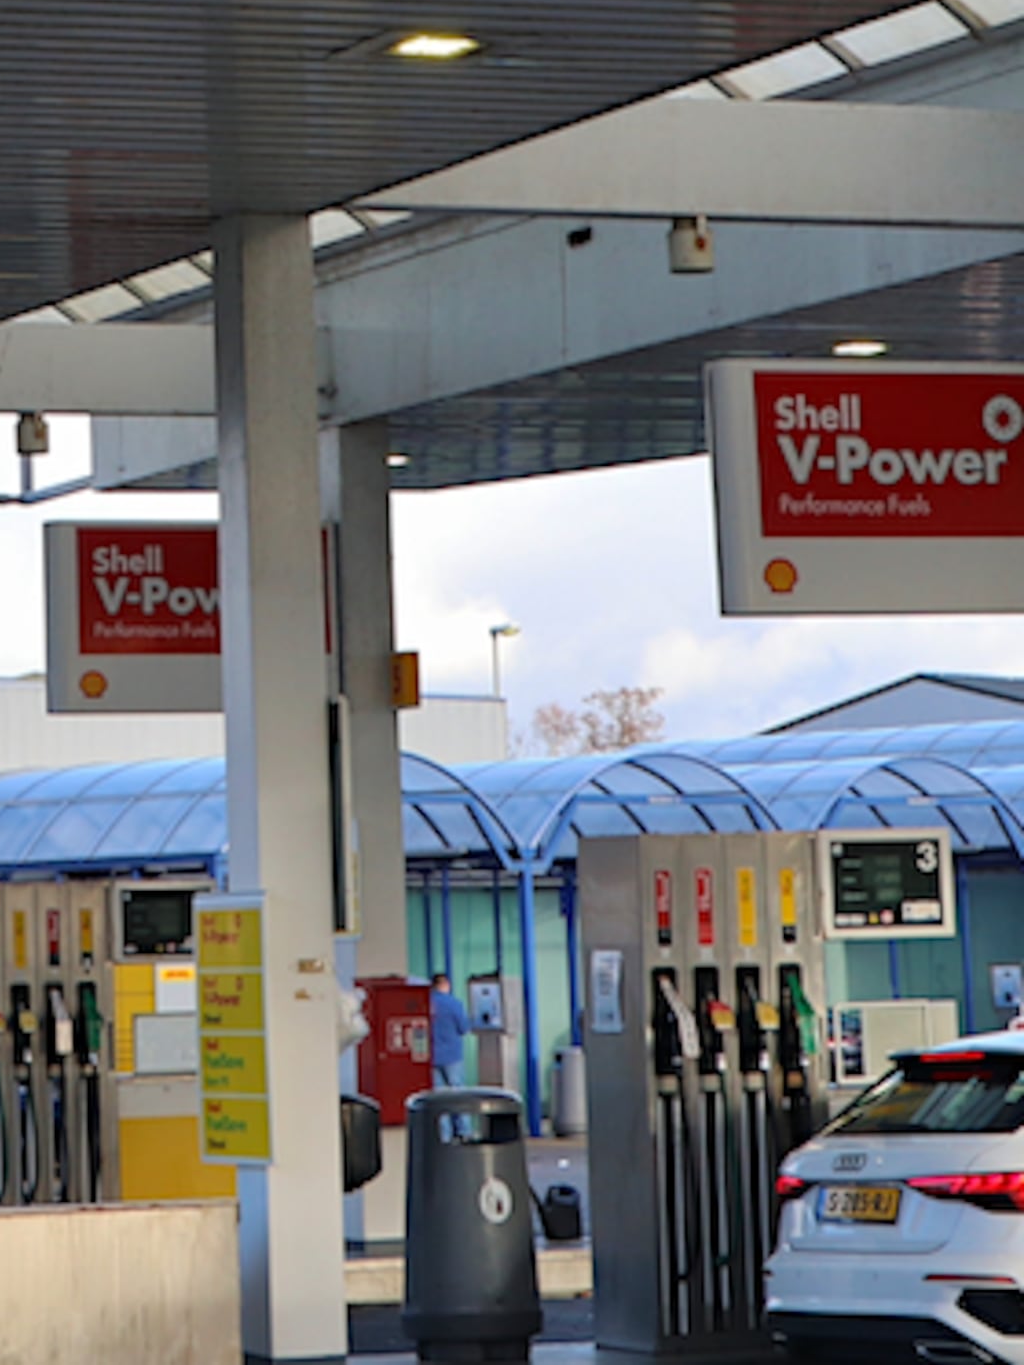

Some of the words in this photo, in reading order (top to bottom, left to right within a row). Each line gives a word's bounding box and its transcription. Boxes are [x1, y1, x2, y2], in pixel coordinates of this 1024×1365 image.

[774, 394, 861, 431] Shell
[778, 435, 1008, 484] V-Power
[779, 492, 885, 516] Performance
[887, 492, 932, 516] Fuels
[92, 544, 163, 574] Shell
[916, 841, 937, 873] 3
